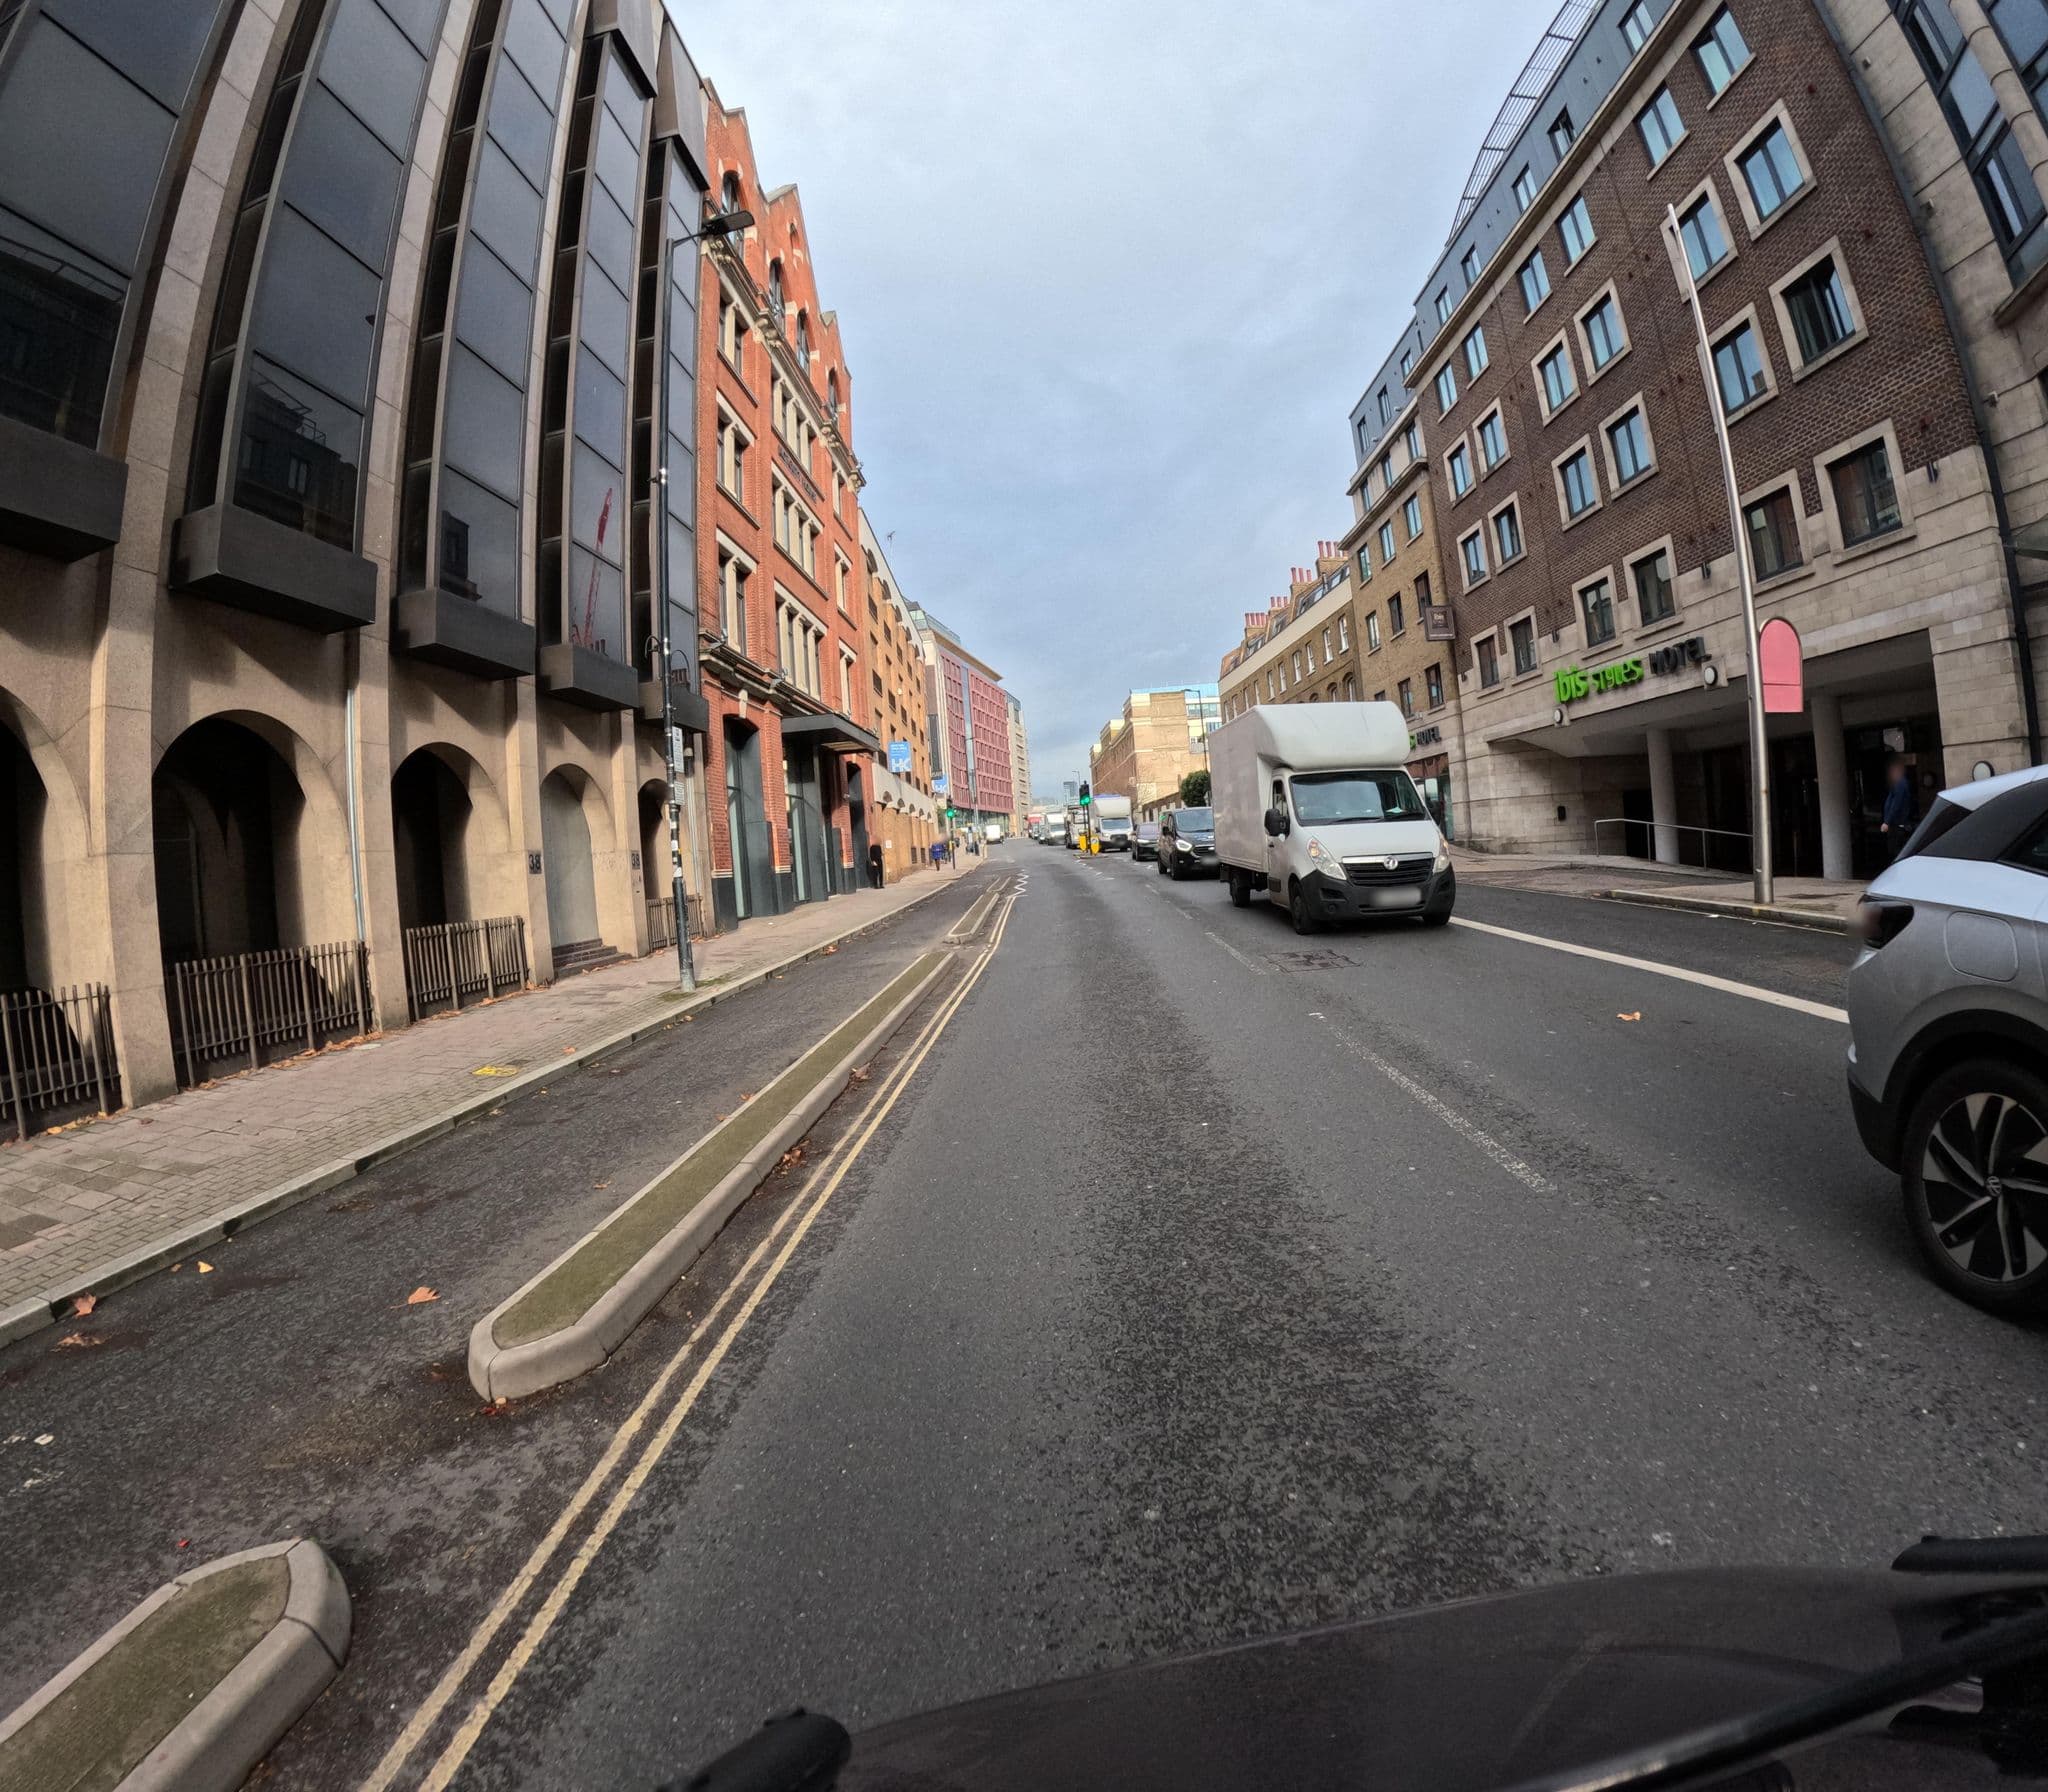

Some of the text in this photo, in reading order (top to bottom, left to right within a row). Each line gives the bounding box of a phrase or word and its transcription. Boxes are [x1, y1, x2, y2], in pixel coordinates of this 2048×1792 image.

[1555, 665, 1589, 704] ibis
[1649, 637, 1711, 673] HOTEL
[529, 854, 541, 869] 38
[631, 853, 641, 867] 38
